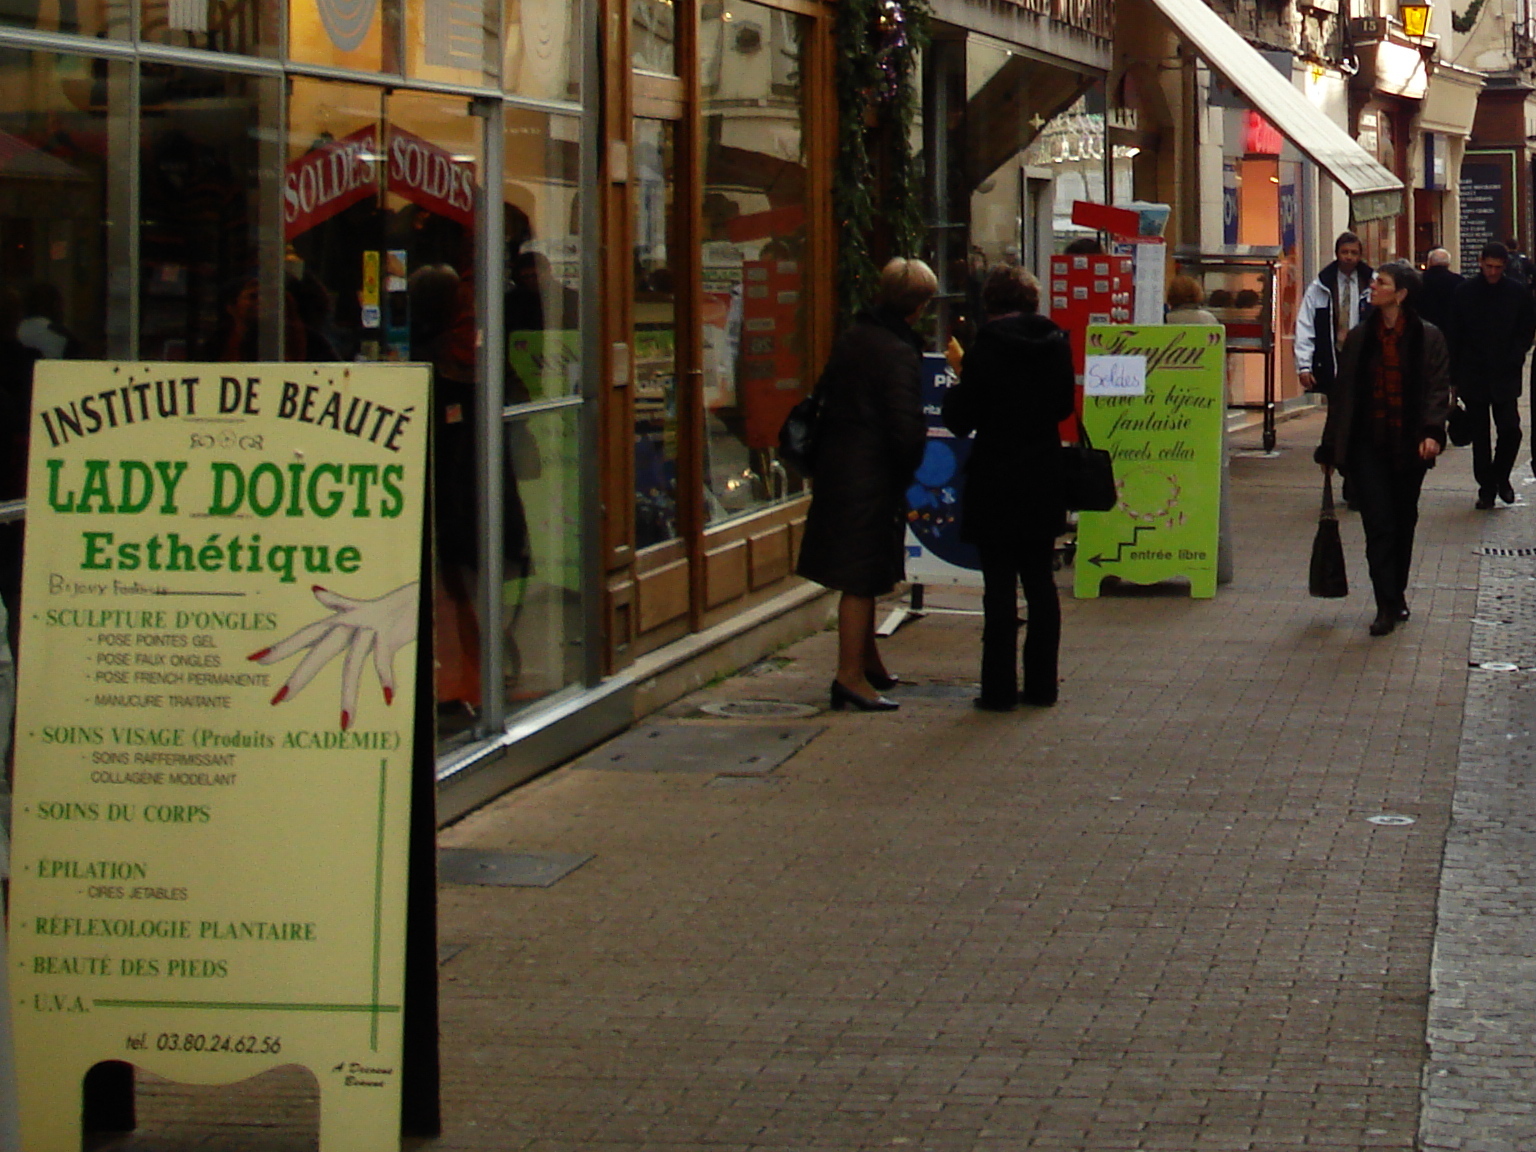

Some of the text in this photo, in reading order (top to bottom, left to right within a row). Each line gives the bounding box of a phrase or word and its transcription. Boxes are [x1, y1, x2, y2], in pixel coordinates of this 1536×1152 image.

[285, 137, 376, 223] SOLDES
[391, 137, 473, 212] SOLDES
[1088, 363, 1140, 389] Soldes
[1164, 384, 1217, 414] bijoux
[40, 376, 415, 453] INSTITUT DE BEAUTÉ
[1107, 409, 1193, 440] fantaisie
[46, 459, 404, 519] LADY DOIGTS
[81, 531, 362, 583] Esthétique
[1130, 548, 1206, 561] entrée libre
[46, 609, 277, 631] SCULPTURE D'ONGLES
[97, 633, 216, 648] POSE POINTES GEL
[97, 652, 221, 667] POSE FAUX ONGLES
[95, 670, 271, 687] POSE FRENCH PERMANENTE
[94, 694, 231, 709] MANUCURE TRAITANTE
[41, 727, 103, 746] SOINS
[111, 728, 185, 747] VISAGE
[192, 728, 275, 749] (Produits
[91, 752, 236, 767] SOINS RAFFERMISSANT
[168, 771, 237, 786] MODELANT
[37, 802, 211, 824] SOINS DU CORPS
[37, 857, 147, 881] ÉPILATION
[87, 886, 188, 902] CIRES JETABLES
[200, 920, 317, 942] PLANTAIRE
[33, 953, 228, 978] BEAUTÉ DES PIEDS
[34, 994, 91, 1013] U.V.A.
[157, 1033, 281, 1055] 03.80.24.62.56
